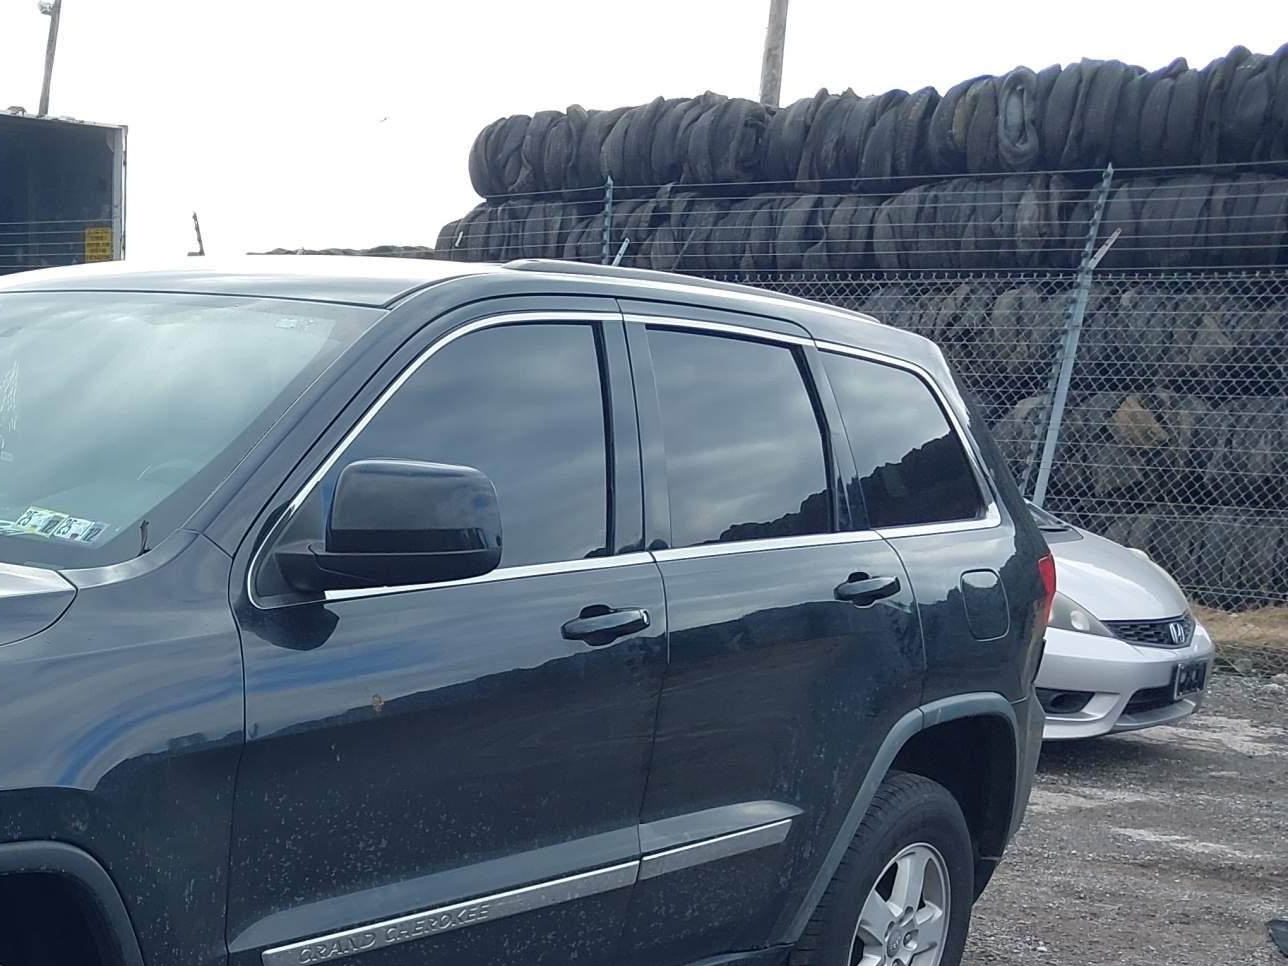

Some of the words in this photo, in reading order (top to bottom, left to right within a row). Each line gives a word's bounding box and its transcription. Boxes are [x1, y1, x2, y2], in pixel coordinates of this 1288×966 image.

[17, 510, 38, 527] 25
[56, 518, 78, 536] 25
[299, 933, 377, 964] GRAND
[385, 904, 490, 943] CHEROKEE
